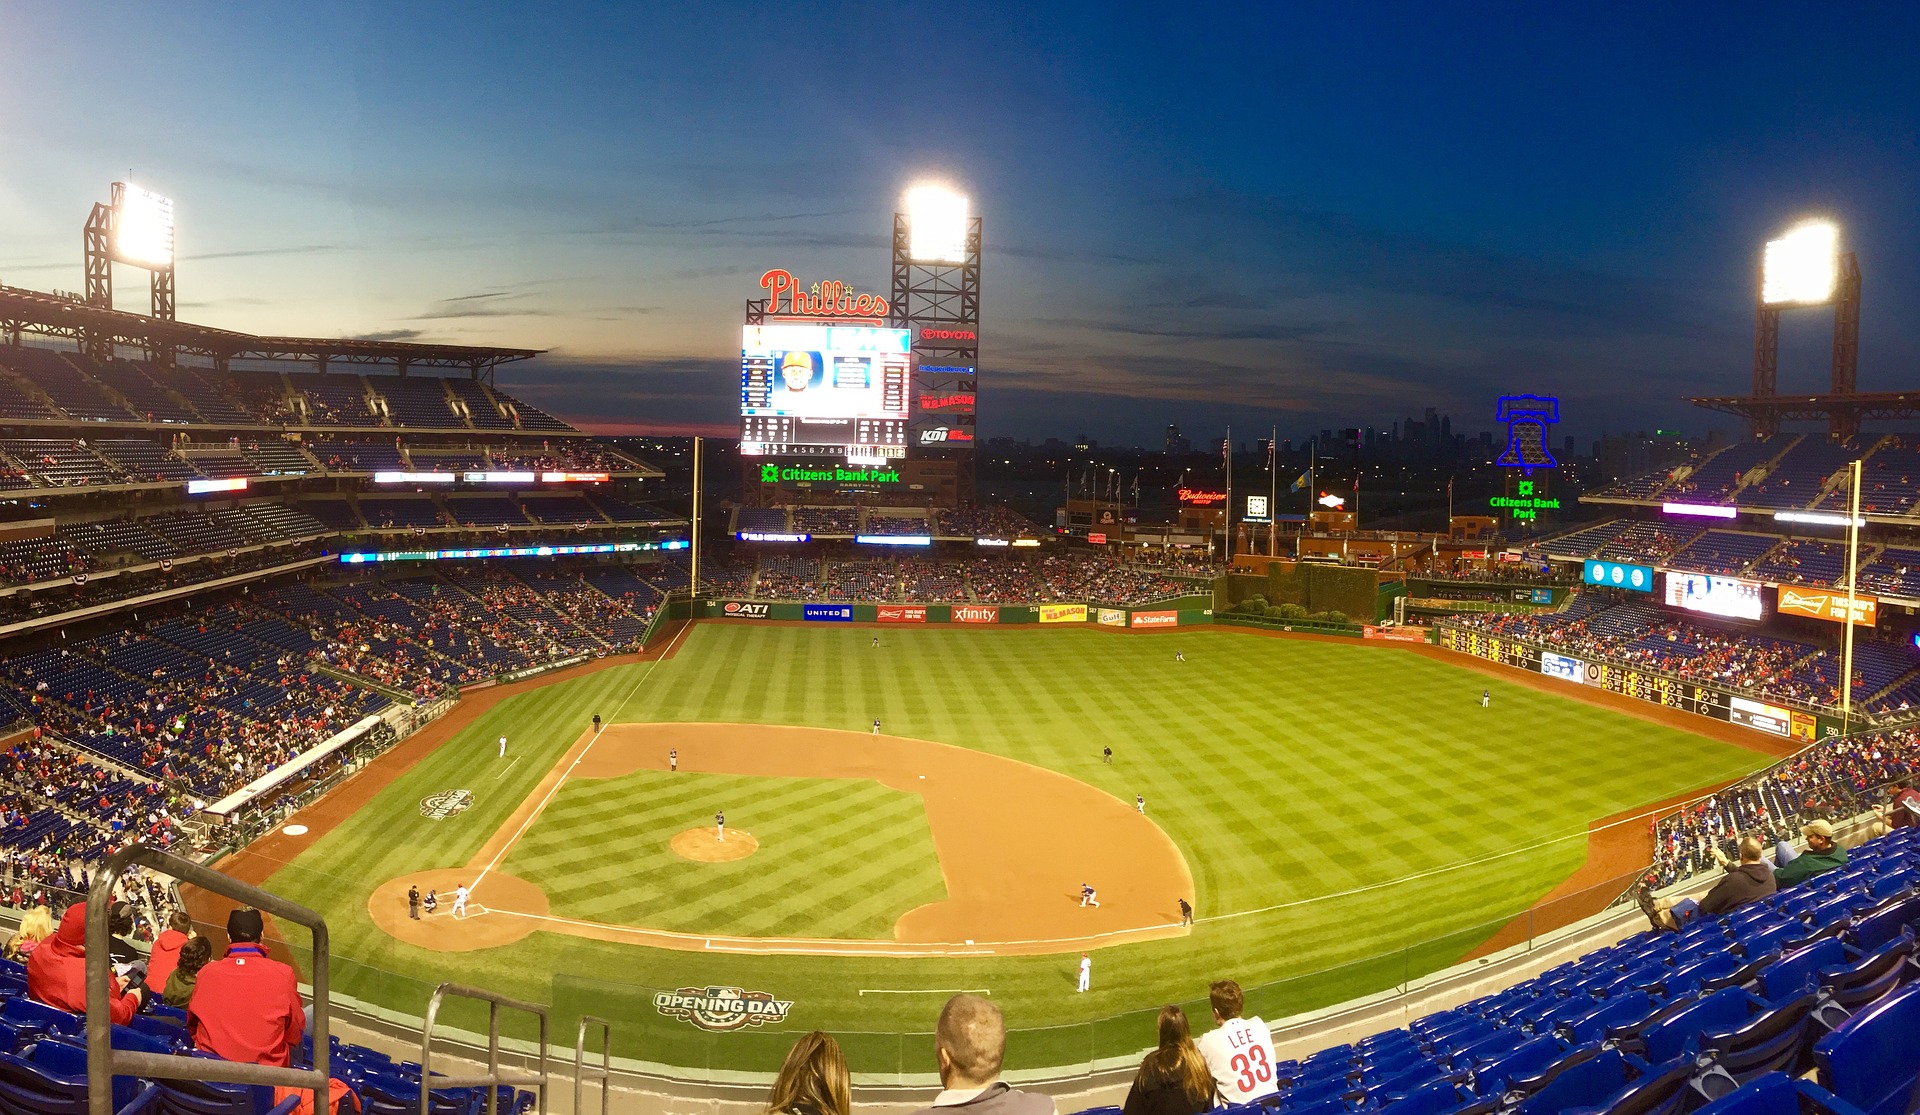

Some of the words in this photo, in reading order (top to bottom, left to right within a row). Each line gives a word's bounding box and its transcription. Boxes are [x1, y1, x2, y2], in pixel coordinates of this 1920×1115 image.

[760, 268, 890, 316] Phillies
[934, 331, 976, 340] TOYOTA
[781, 468, 833, 481] Citizens
[836, 469, 869, 482] Bank
[871, 470, 899, 483] Park
[1179, 490, 1227, 500] Budweiser
[1490, 497, 1532, 507] Citizens
[1534, 497, 1560, 508] Bank
[1513, 508, 1536, 519] Park
[739, 604, 769, 614] ATI
[1830, 596, 1849, 608] THIS
[1854, 600, 1875, 612] UD'S
[955, 607, 995, 622] xfinity
[1102, 613, 1121, 622] Gulf
[1830, 607, 1846, 619] FOR
[1826, 726, 1839, 736] 330
[655, 994, 745, 1013] OPENING
[747, 1001, 791, 1015] DAY
[1227, 1028, 1254, 1049] LEE
[1230, 1044, 1272, 1093] 33
